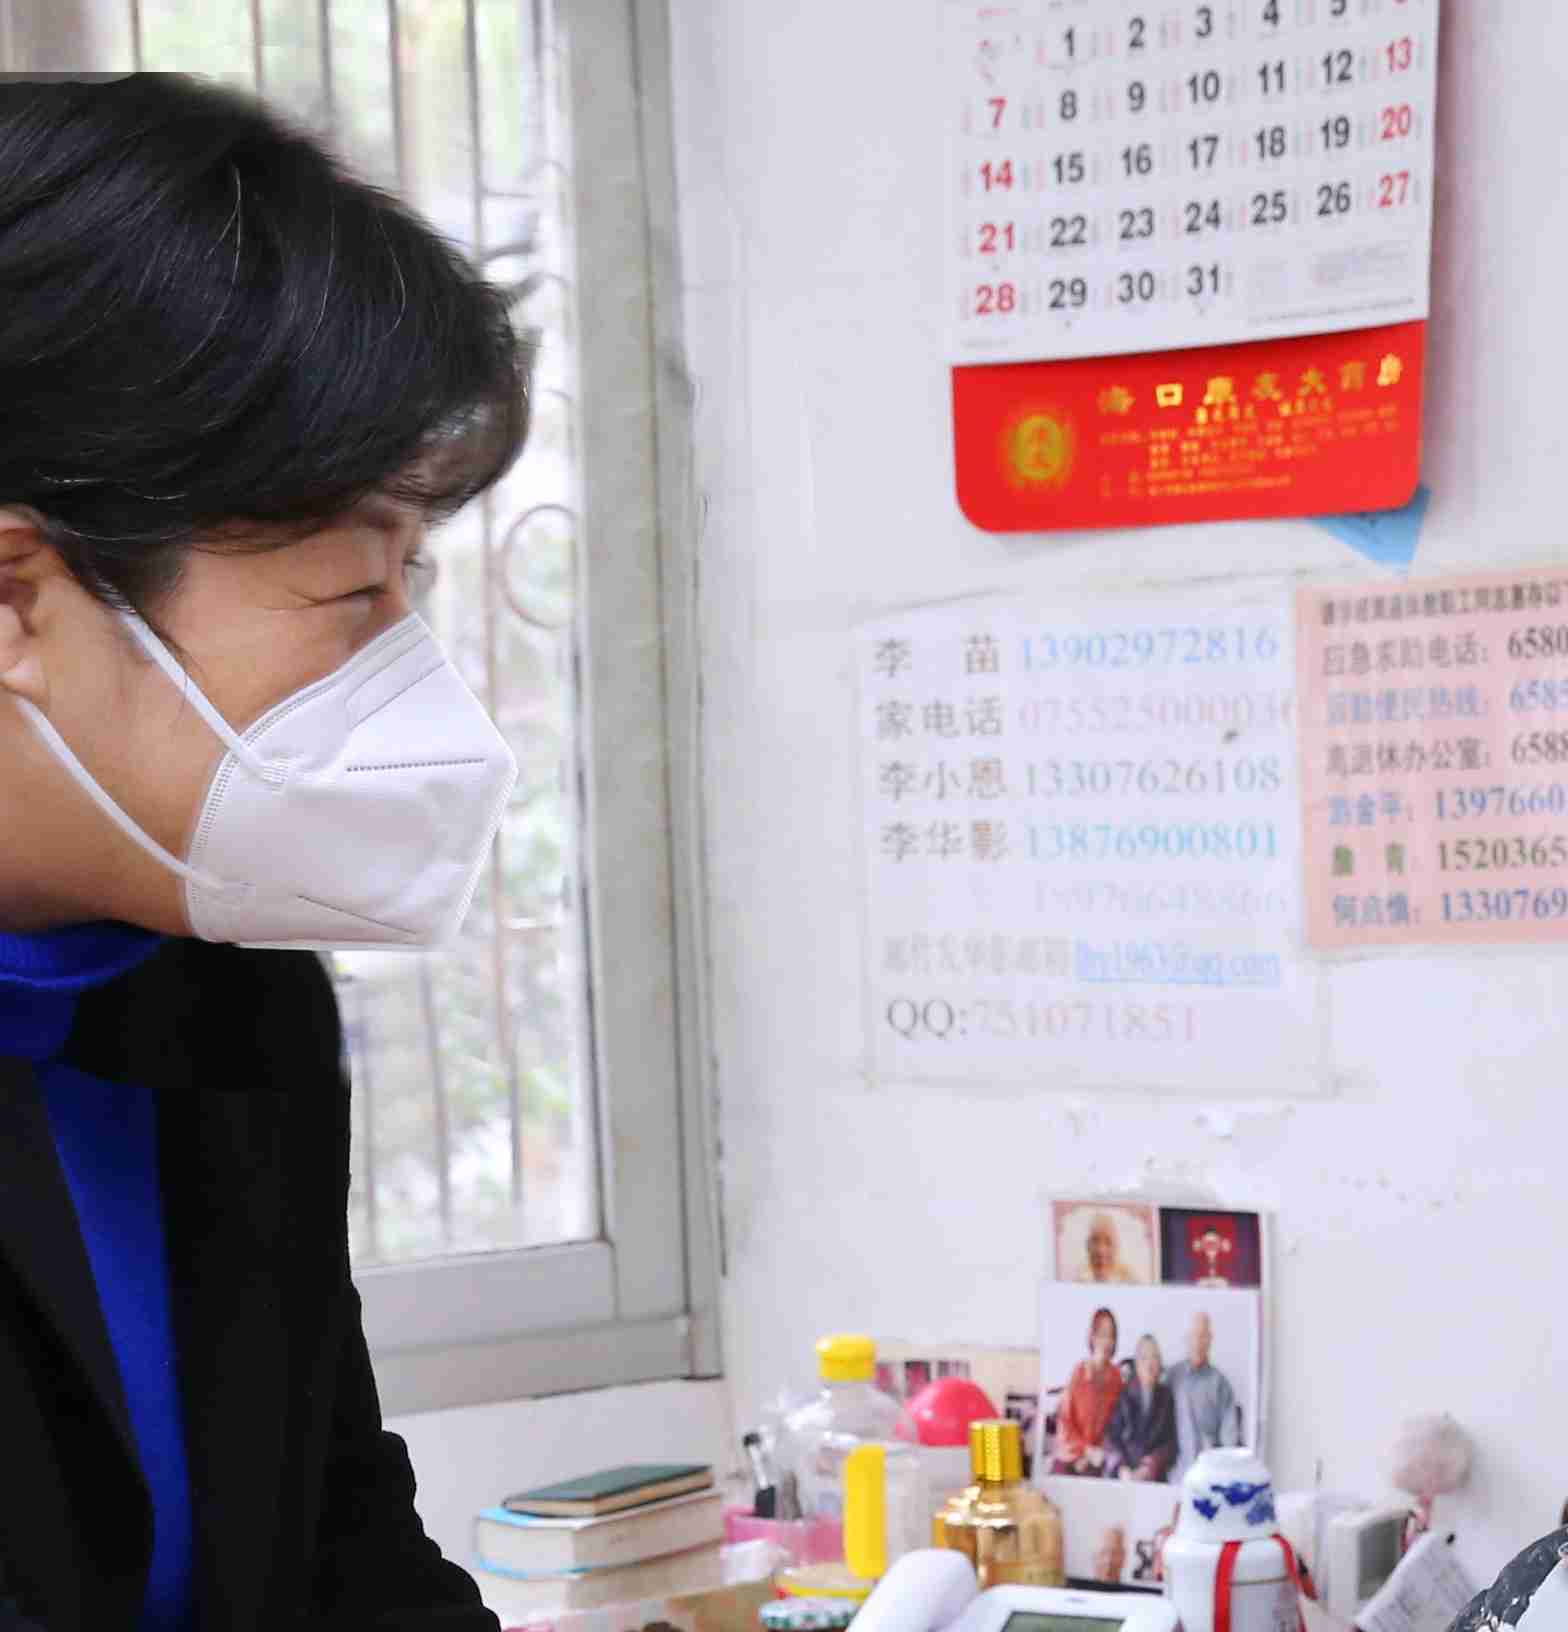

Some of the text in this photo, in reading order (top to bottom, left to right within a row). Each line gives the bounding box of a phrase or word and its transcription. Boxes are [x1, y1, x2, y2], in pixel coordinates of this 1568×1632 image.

[1063, 27, 1076, 57] 1
[1129, 18, 1145, 48] 2
[1196, 6, 1212, 38] 3
[1263, 0, 1279, 26] 4
[989, 37, 1412, 128] 7 8 9 10 11 12 13
[981, 105, 1411, 191] 14 15 16 17 18 19 20
[979, 171, 1409, 253] 21 22 23 24 25 26 27
[976, 264, 1218, 315] 28 29 30 31
[874, 637, 911, 676] 李
[1020, 626, 1278, 669] 13902972816
[876, 699, 1002, 740] 家电话
[1025, 757, 1281, 796] 13307626108
[1025, 824, 1278, 860] 13876900801
